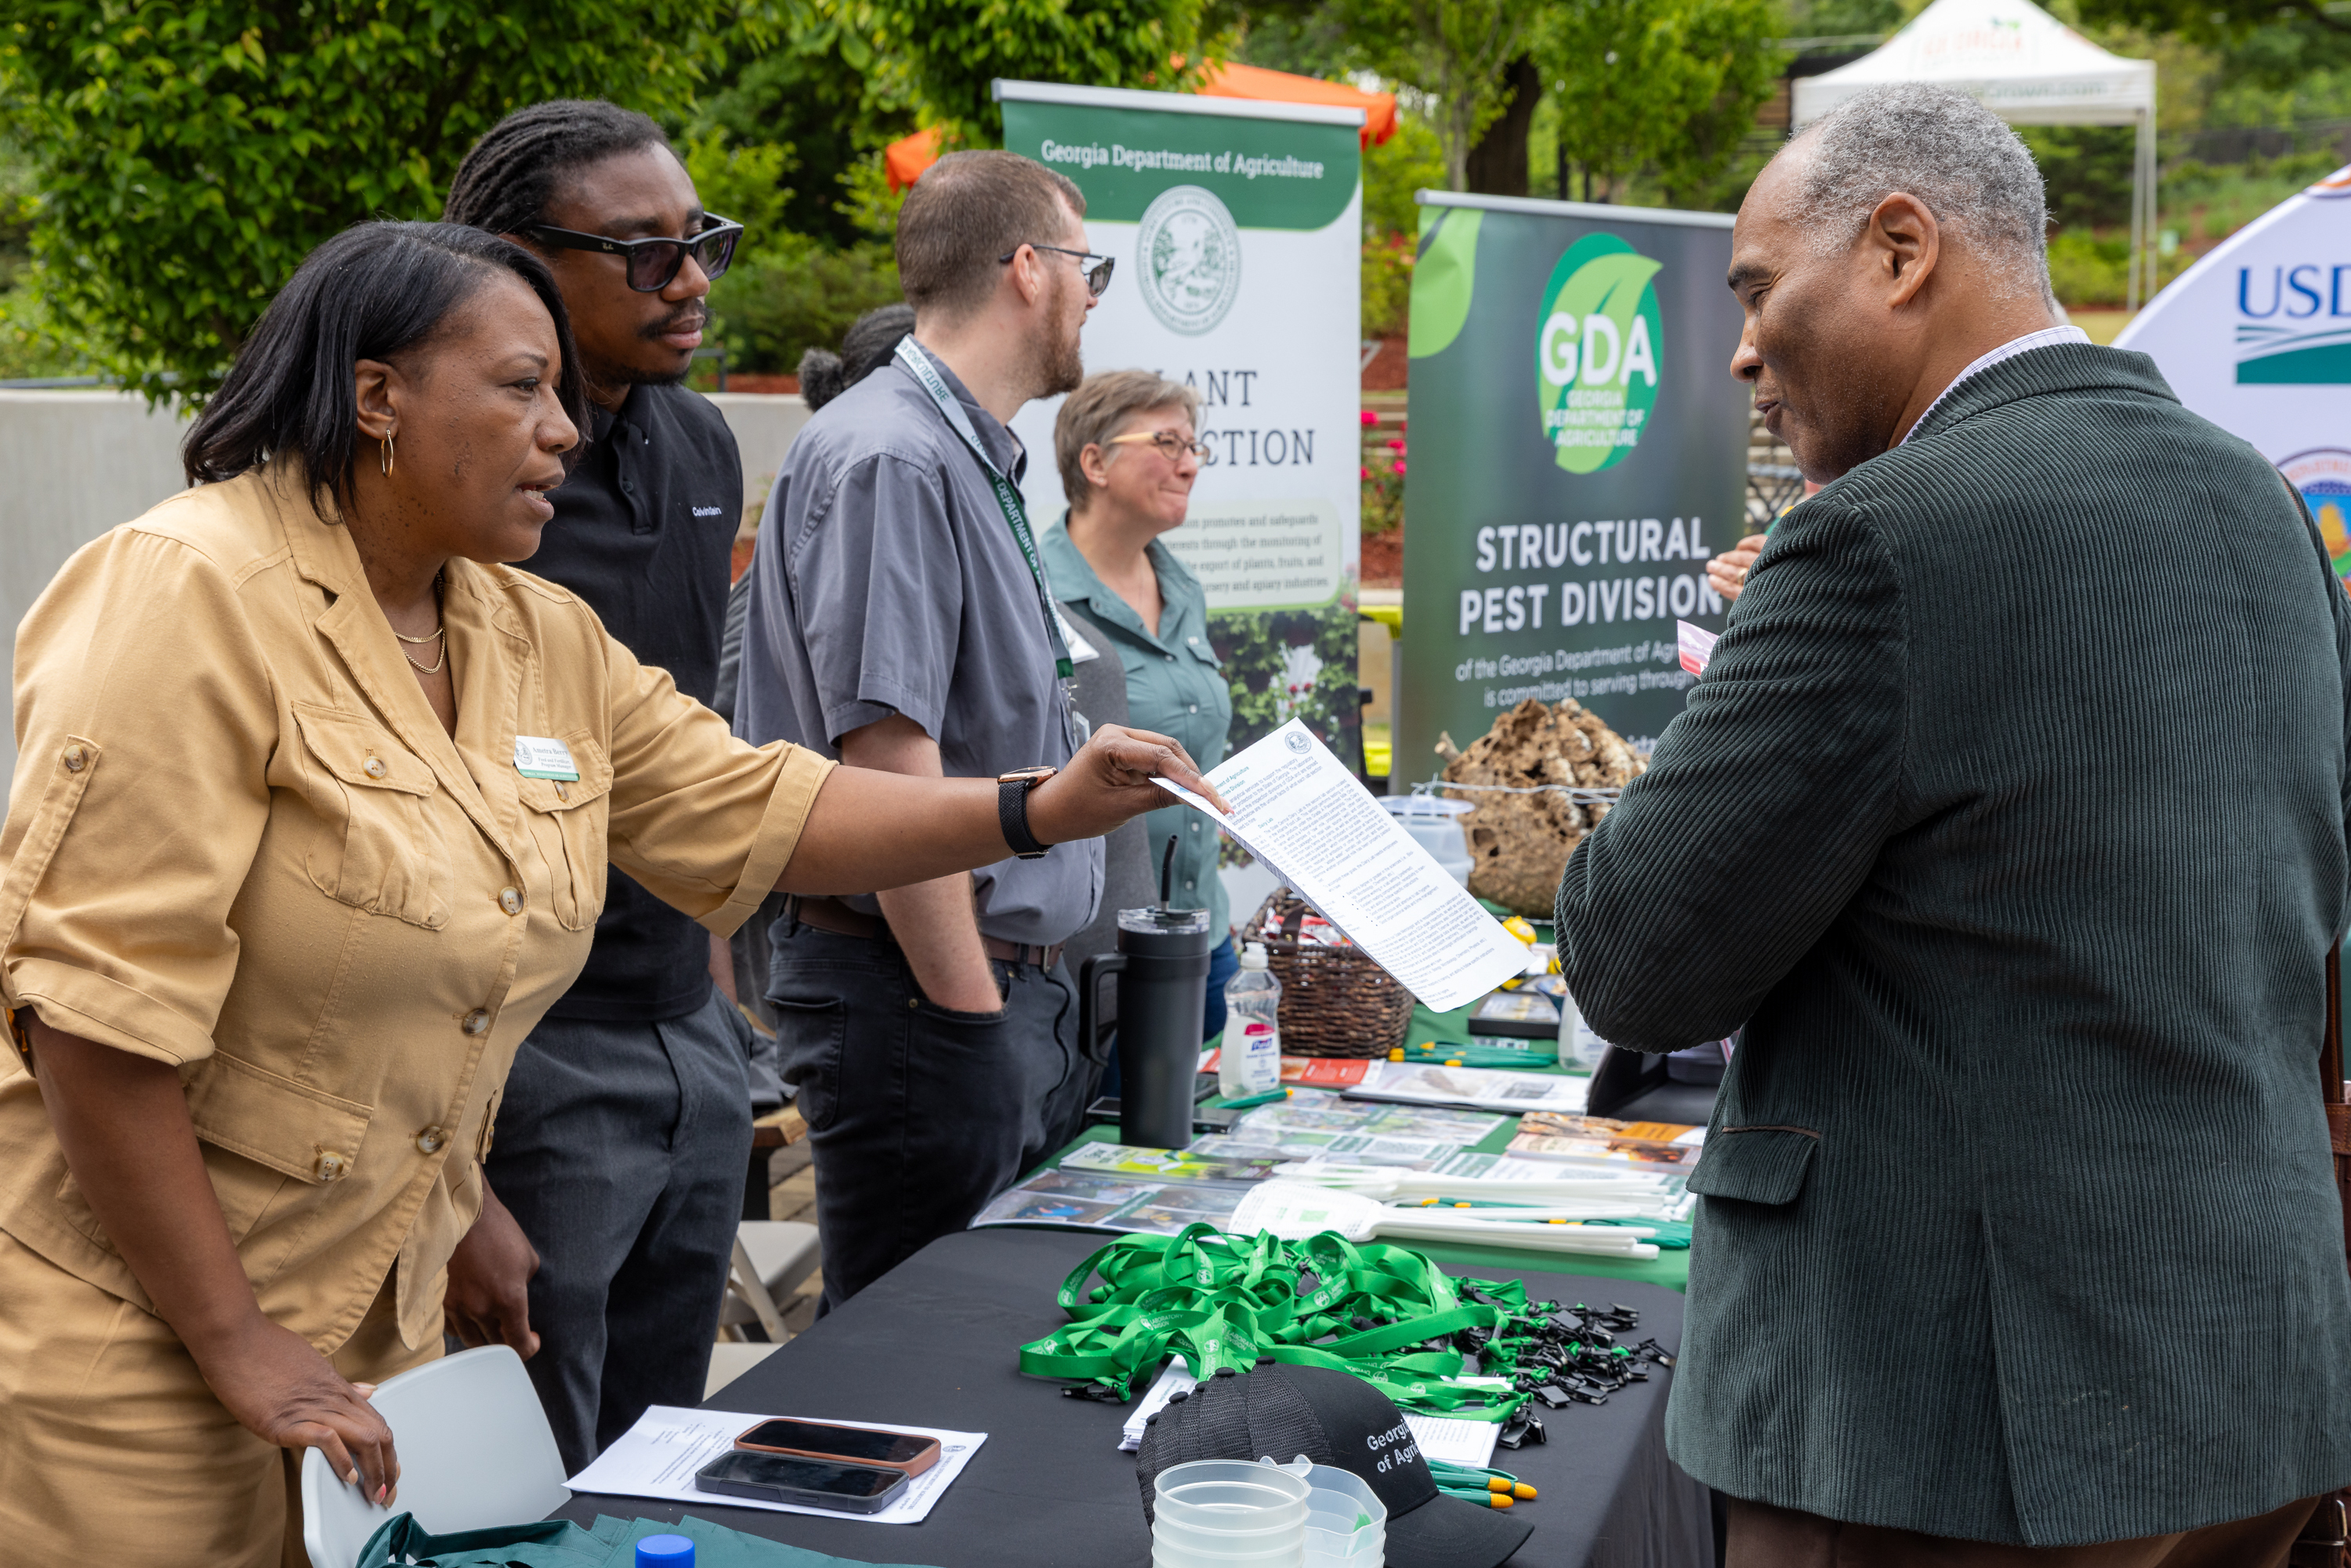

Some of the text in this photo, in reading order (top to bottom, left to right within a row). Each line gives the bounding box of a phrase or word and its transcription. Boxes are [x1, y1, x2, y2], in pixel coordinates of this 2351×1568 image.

[1041, 139, 1324, 179] Georgia Department of Agriculture
[1540, 311, 1657, 387] GDA
[1155, 370, 1258, 407] ANT
[1566, 389, 1624, 408] GEORGIA
[1545, 409, 1645, 428] DEPARTMENT OF
[1554, 429, 1639, 447] AGRICULTURE
[996, 481, 1034, 553] DEPARTMENT
[1248, 514, 1267, 527] and
[1269, 513, 1319, 529] safeguards
[1201, 536, 1237, 553] through
[1240, 536, 1256, 549] the
[1258, 534, 1310, 549] monitoring
[1313, 533, 1322, 545] of
[1475, 517, 1711, 572] STRUCTURAL
[1199, 558, 1230, 574] export
[1231, 557, 1242, 570] of
[1306, 553, 1324, 567] and
[1233, 578, 1251, 592] and
[1459, 574, 1722, 636] PEST DIVISION
[1455, 657, 1473, 682] of
[1474, 657, 1498, 679] the
[1498, 650, 1555, 678] Georgia
[1555, 644, 1633, 673] Department
[1632, 639, 1651, 663] of
[1483, 686, 1497, 708] is
[1497, 676, 1573, 707] committed
[1573, 677, 1589, 697] to
[1590, 671, 1639, 696] serving
[1150, 1313, 1184, 1326] LABORATORY
[1377, 1454, 1393, 1473] of
